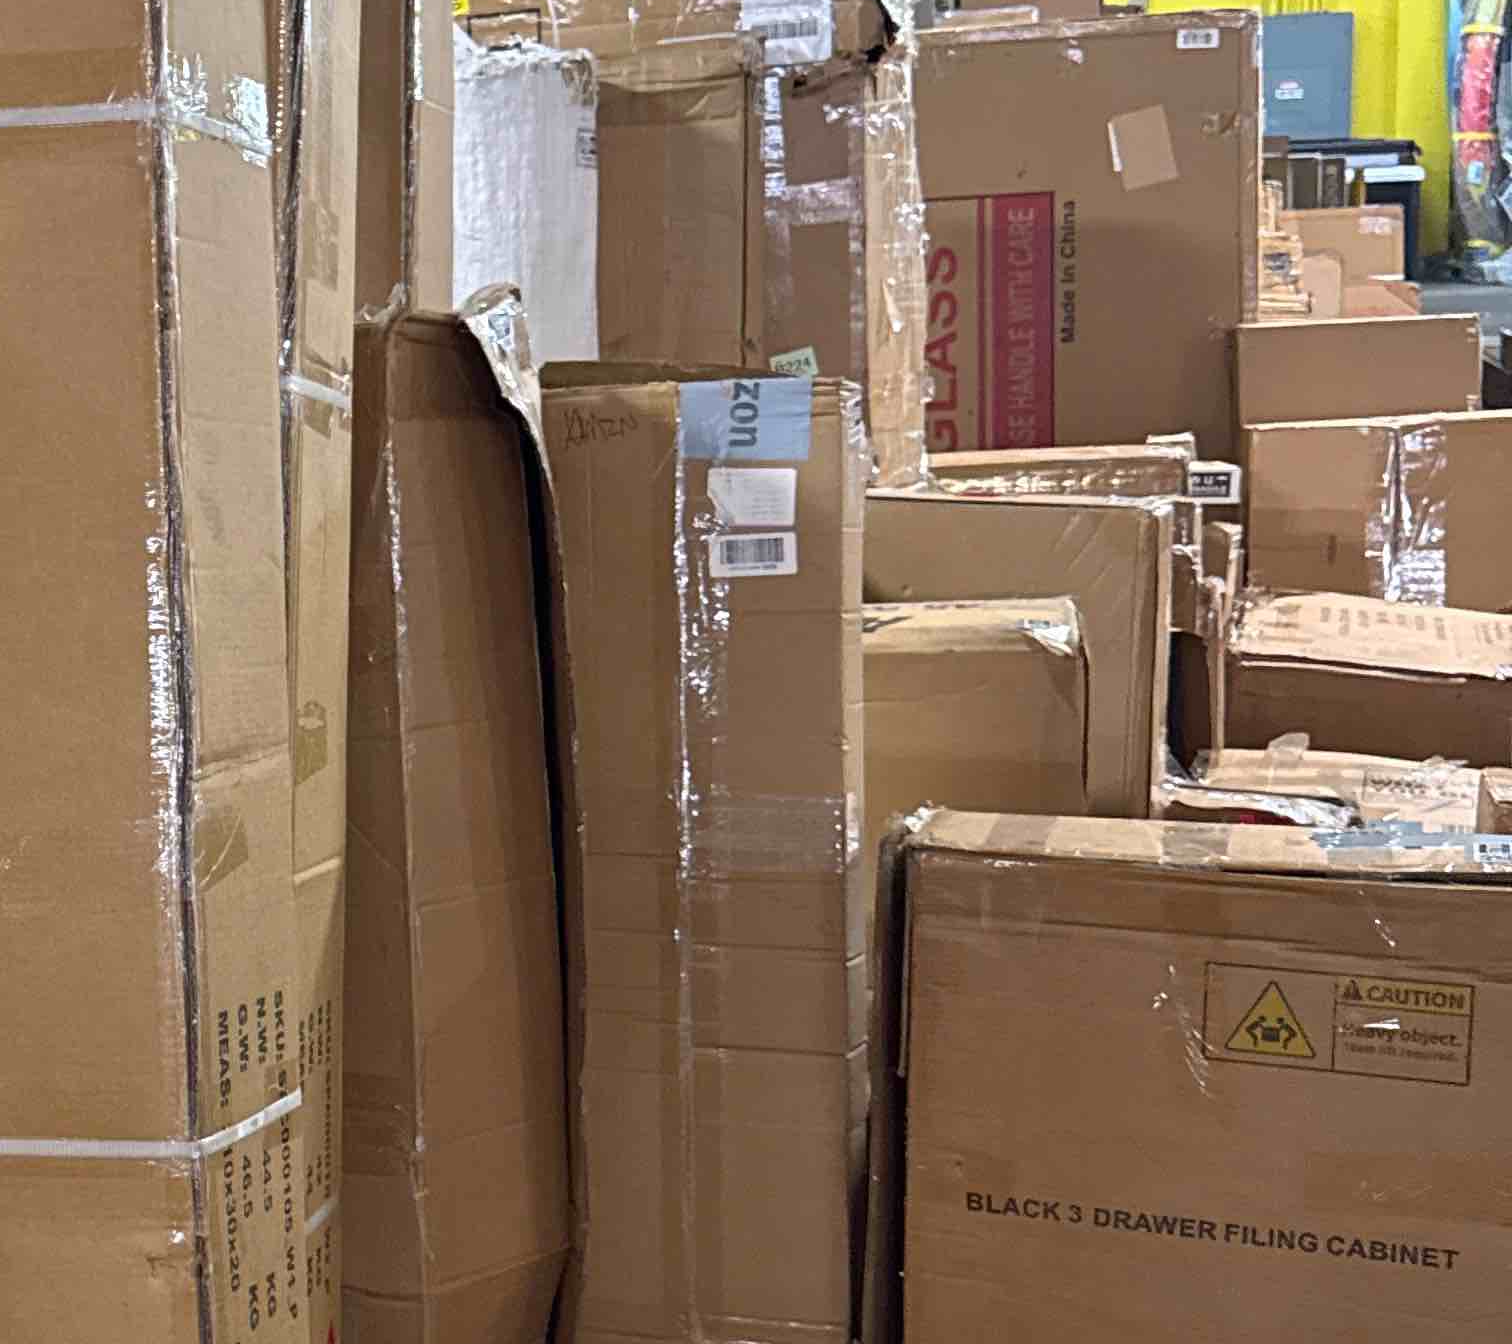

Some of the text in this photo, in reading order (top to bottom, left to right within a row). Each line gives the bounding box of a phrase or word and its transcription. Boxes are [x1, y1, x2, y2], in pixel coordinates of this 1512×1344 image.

[1008, 207, 1036, 264] CARE
[1059, 200, 1075, 259] China
[924, 246, 959, 452] GLASS
[1060, 289, 1075, 344] Made
[1008, 327, 1036, 410] HANDLE
[273, 990, 285, 1061] SKU:
[1367, 984, 1465, 1009] CAUTION
[218, 1008, 232, 1108] MEAS:
[238, 1003, 260, 1332] G.W: 46.5 KG
[256, 996, 277, 1318] N.W: 44.5 KG
[965, 1191, 1461, 1270] BLACK 3 DRAWER FILING CABINET
